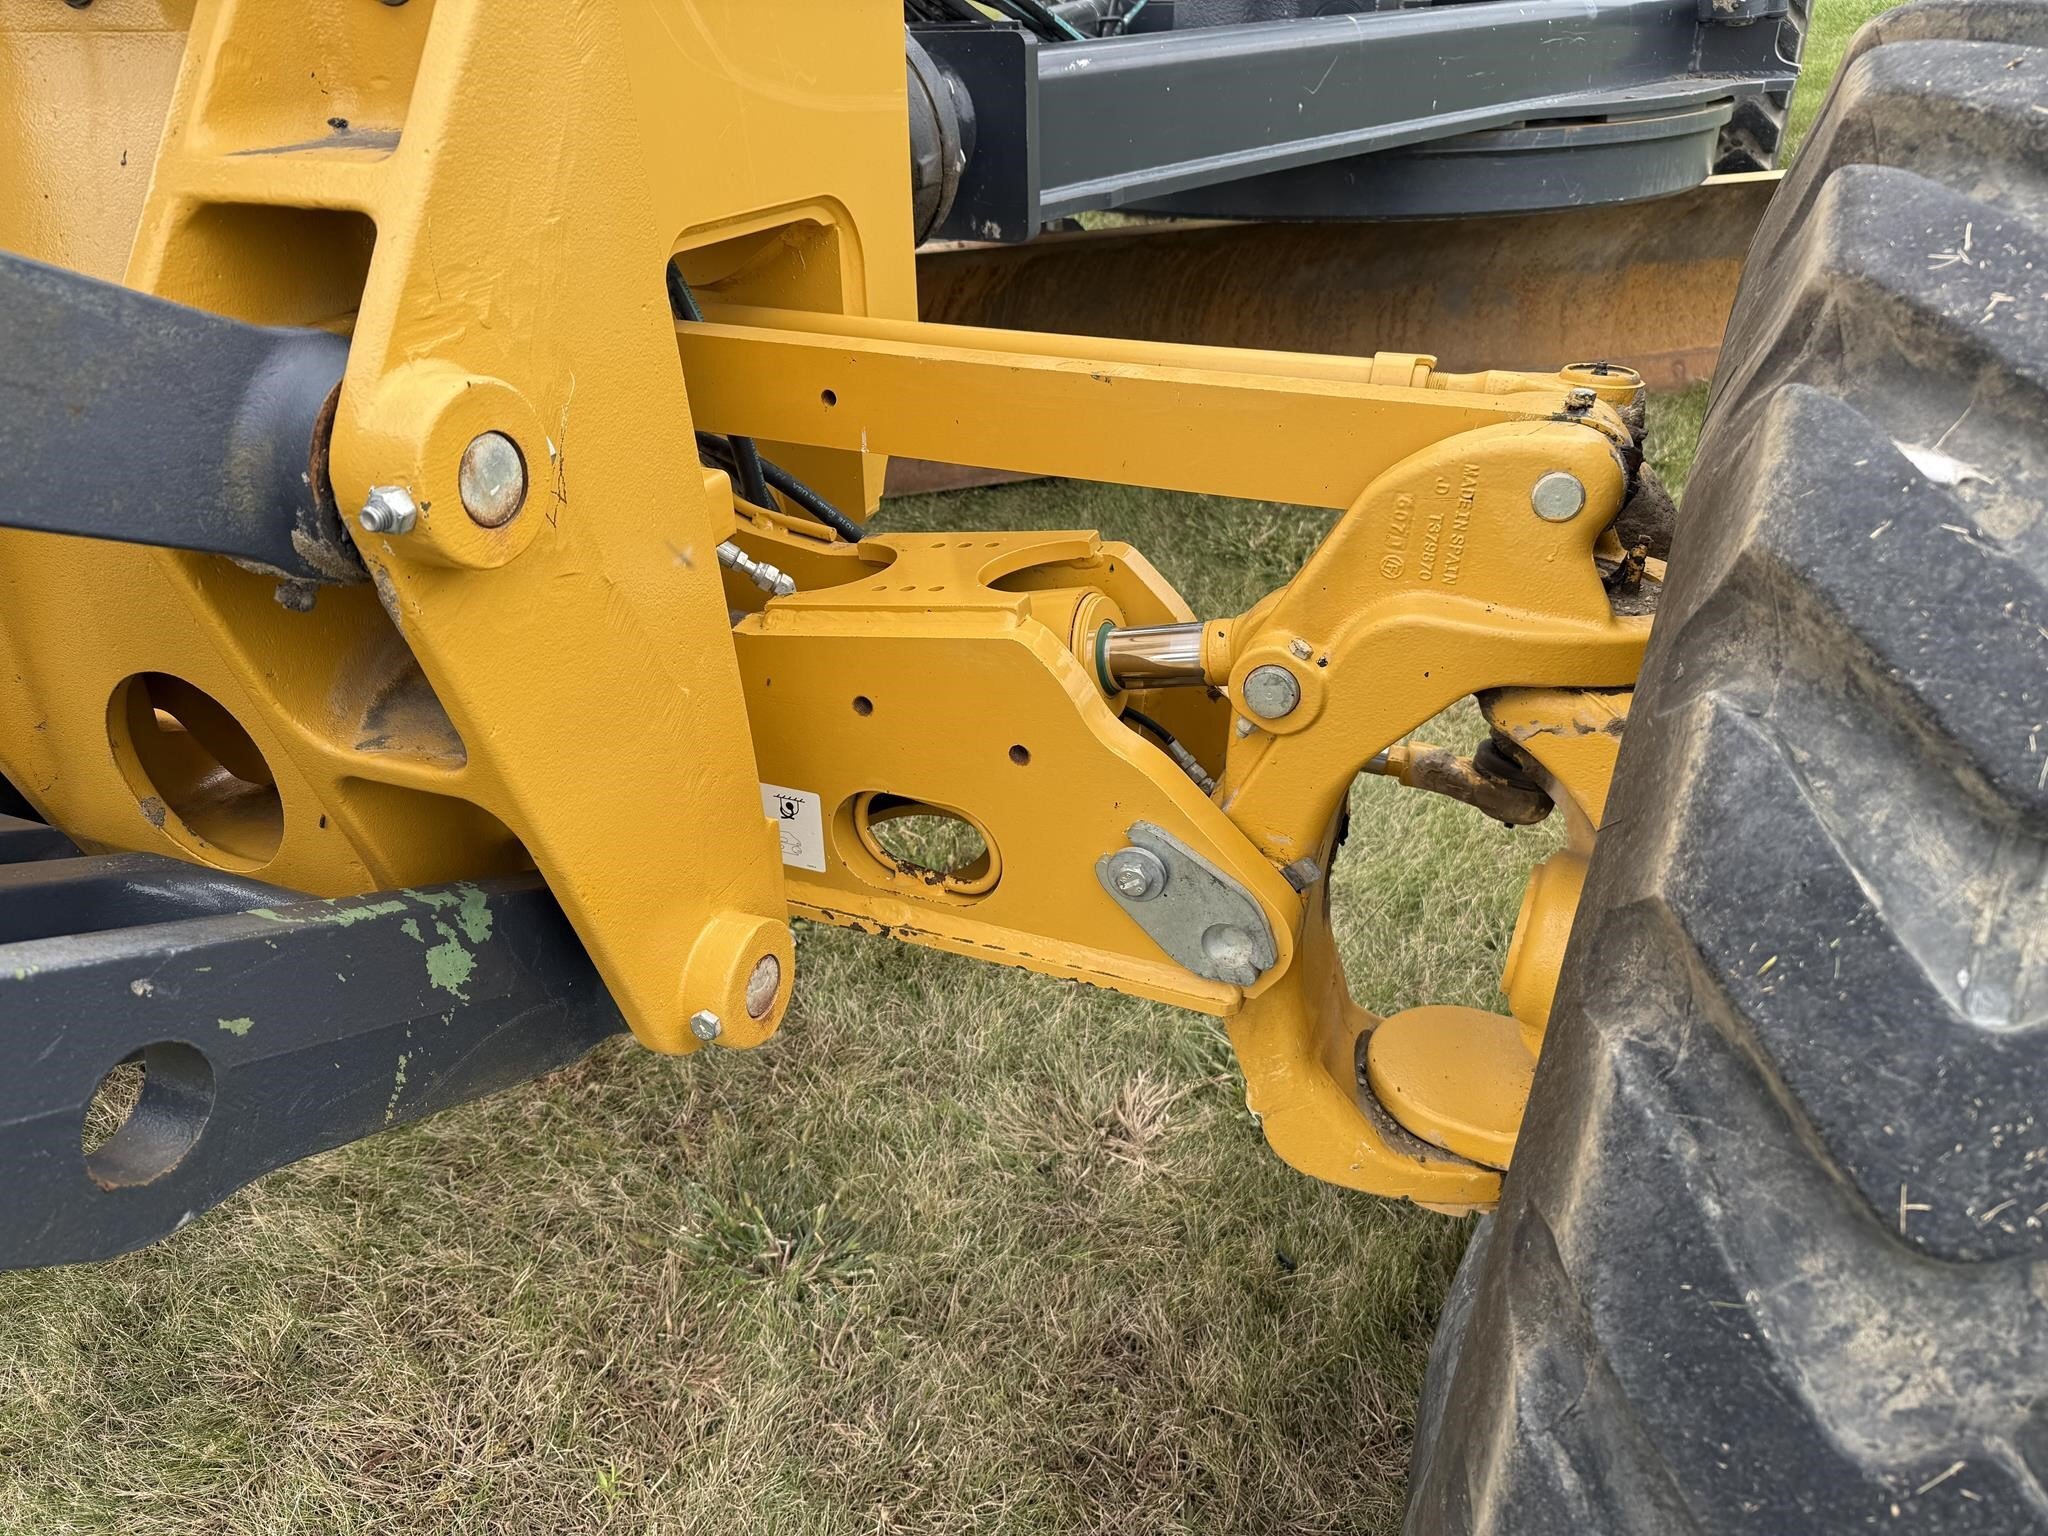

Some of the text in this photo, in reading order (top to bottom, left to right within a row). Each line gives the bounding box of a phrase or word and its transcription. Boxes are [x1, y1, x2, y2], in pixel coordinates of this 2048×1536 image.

[1442, 463, 1480, 585] MADE IN SPAIN
